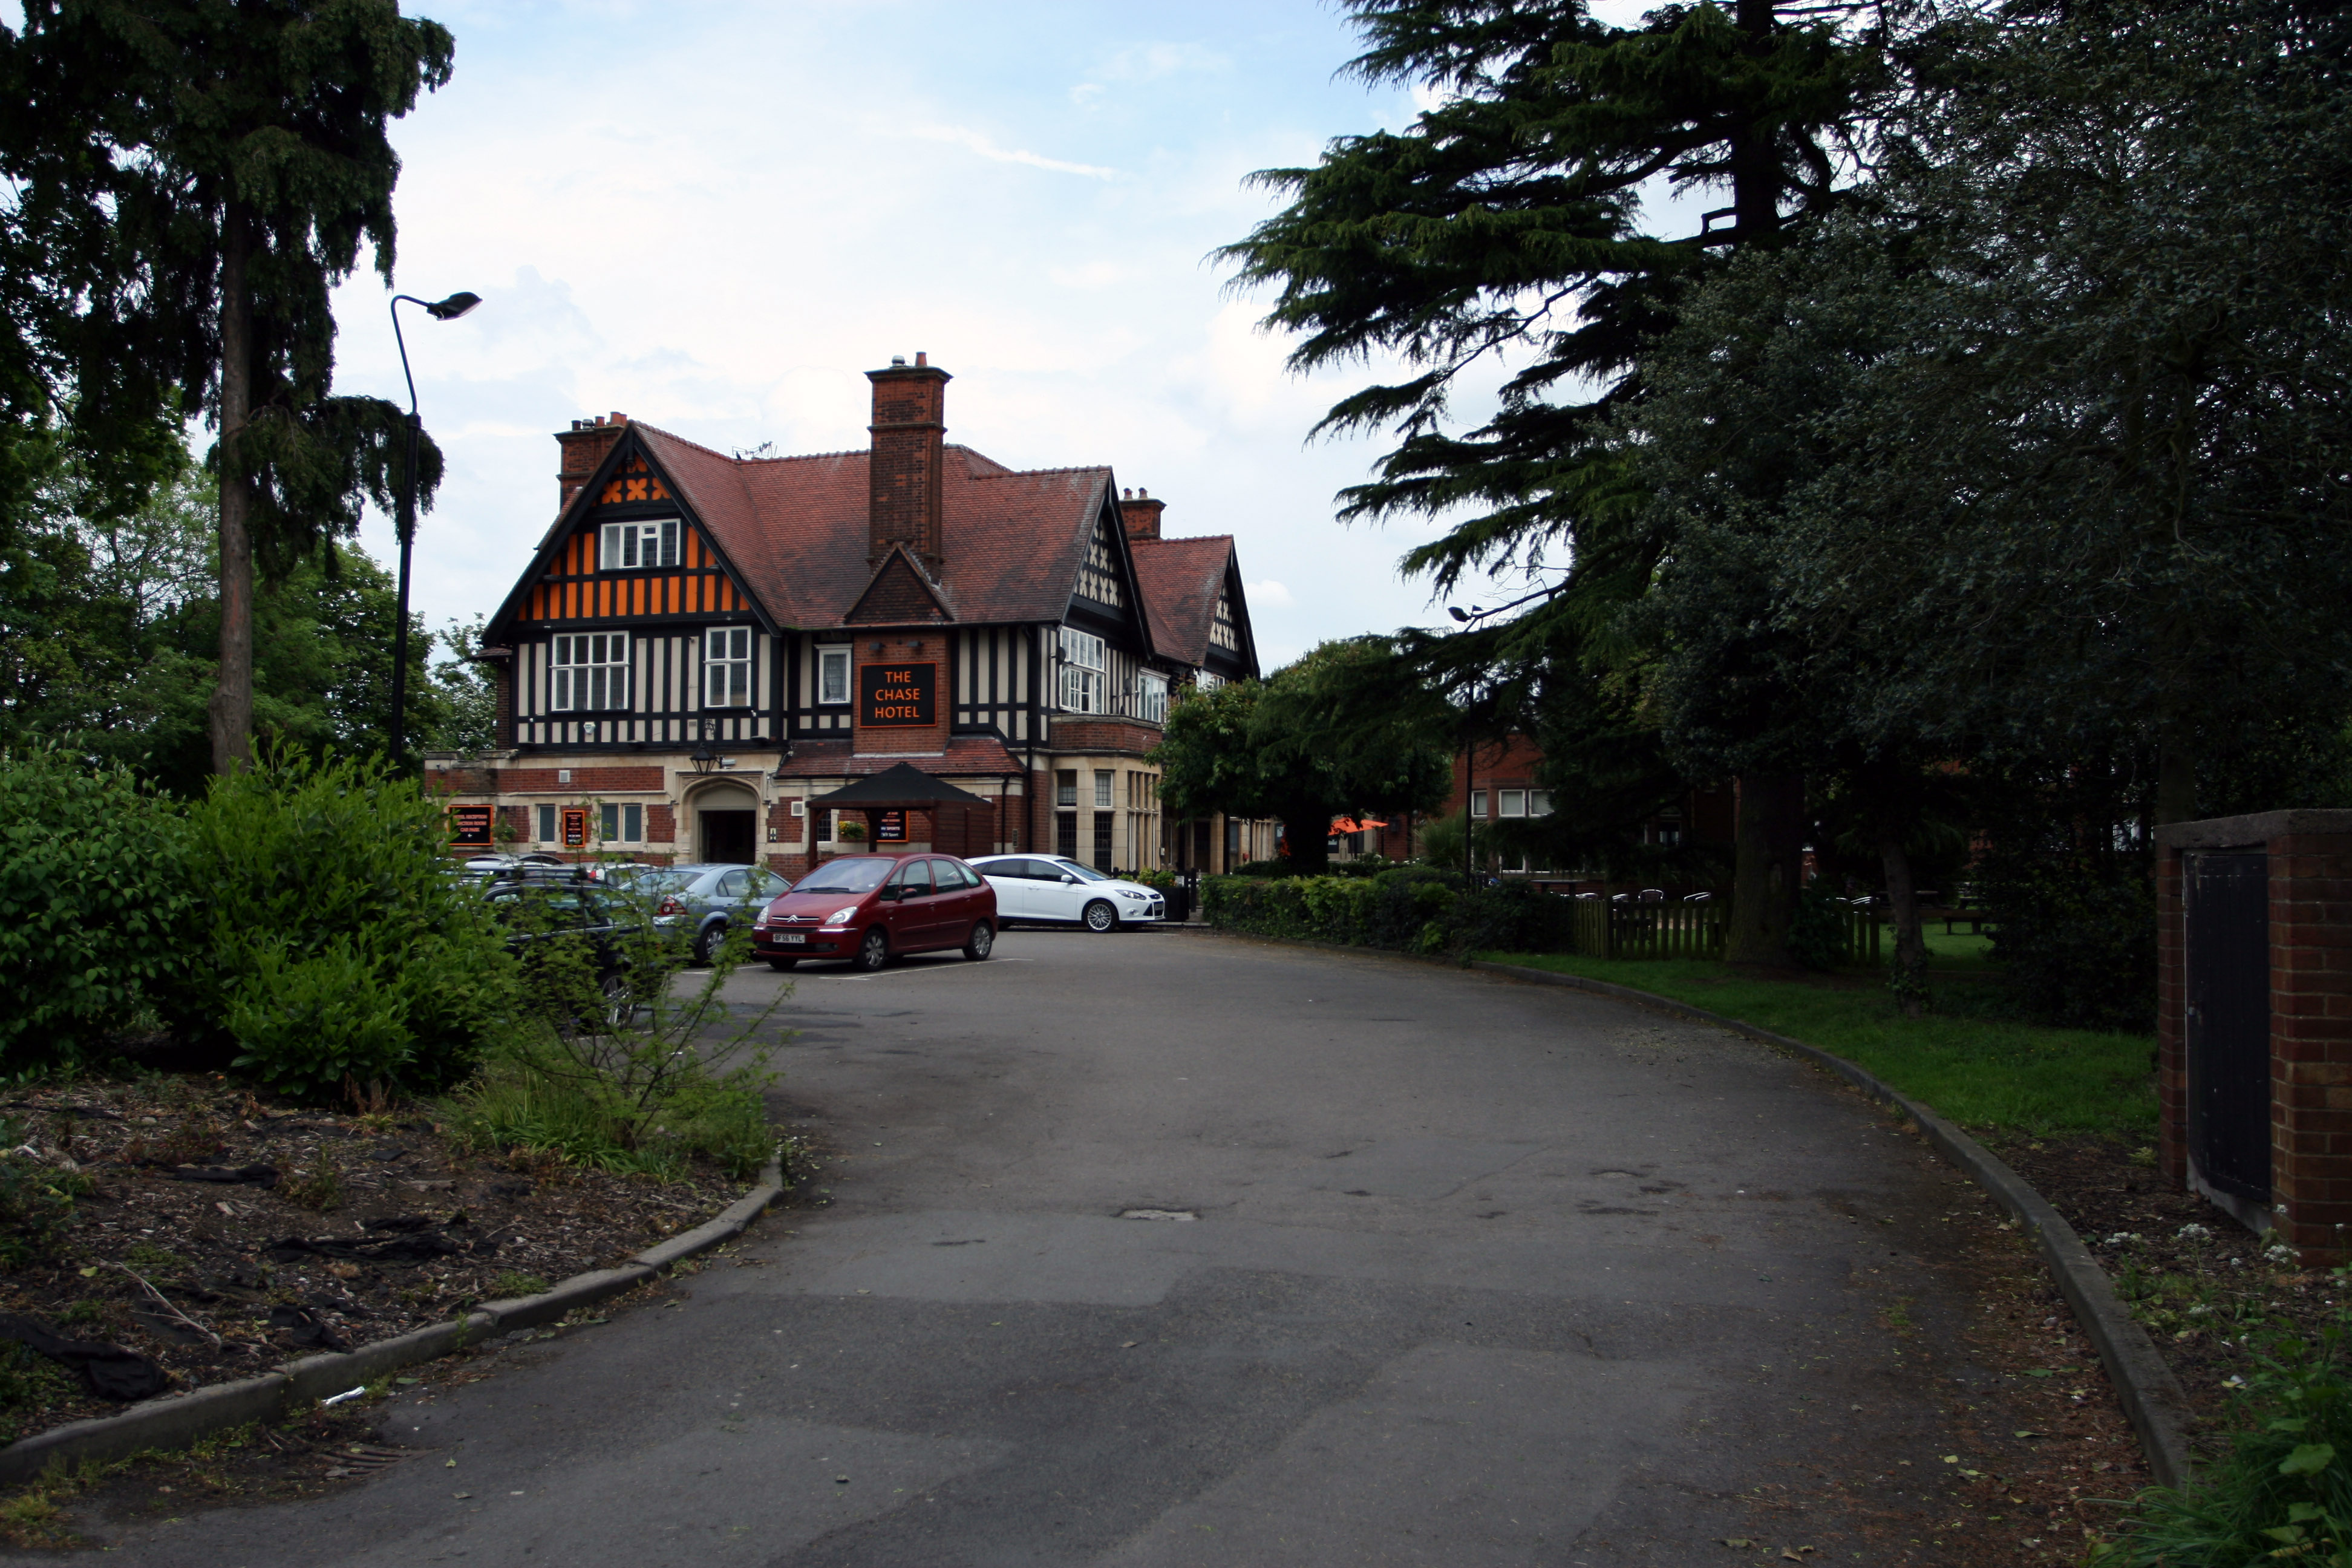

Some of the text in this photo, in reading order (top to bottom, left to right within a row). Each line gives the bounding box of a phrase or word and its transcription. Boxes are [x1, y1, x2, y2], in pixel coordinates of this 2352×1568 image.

[885, 671, 911, 682] THE
[875, 688, 920, 701] CHASE
[875, 707, 920, 718] HOTEL
